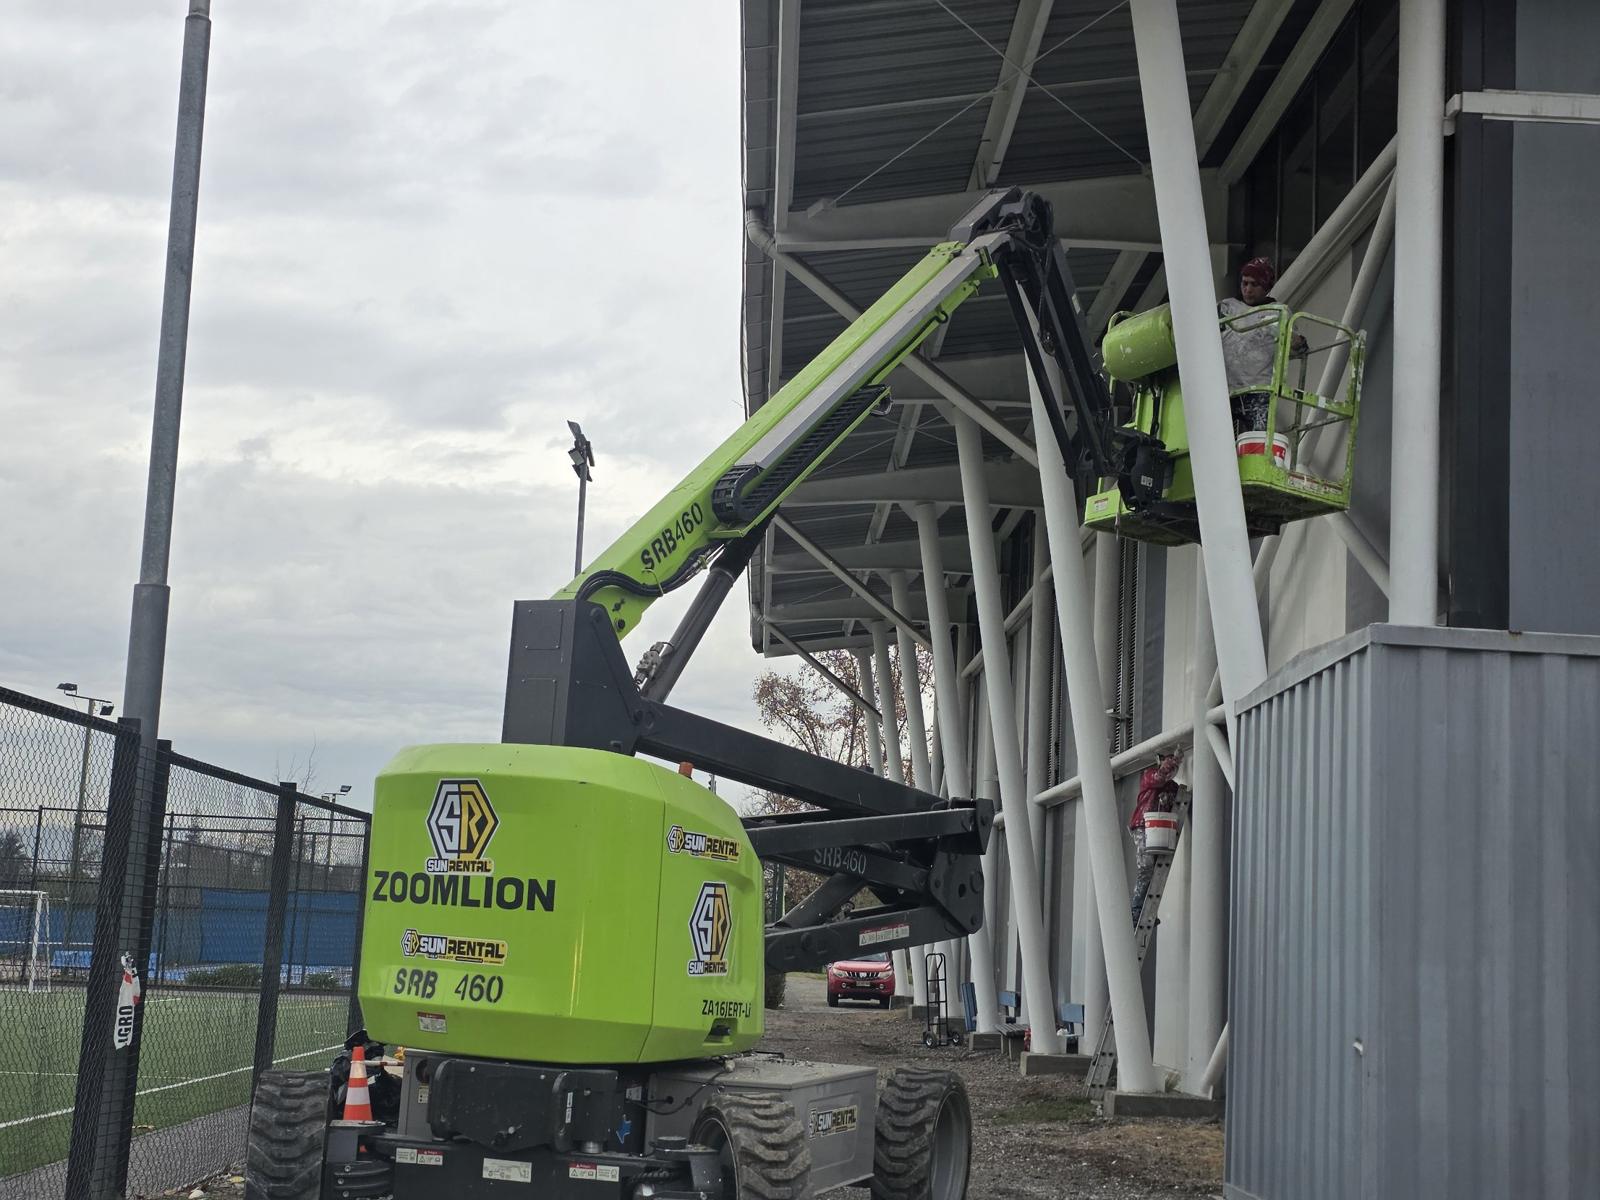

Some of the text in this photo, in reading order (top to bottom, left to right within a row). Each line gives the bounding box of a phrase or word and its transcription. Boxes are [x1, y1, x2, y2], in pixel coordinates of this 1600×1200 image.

[641, 502, 703, 570] SRB460
[372, 870, 556, 912] ZOOMLION
[394, 968, 504, 1004] SRB 460
